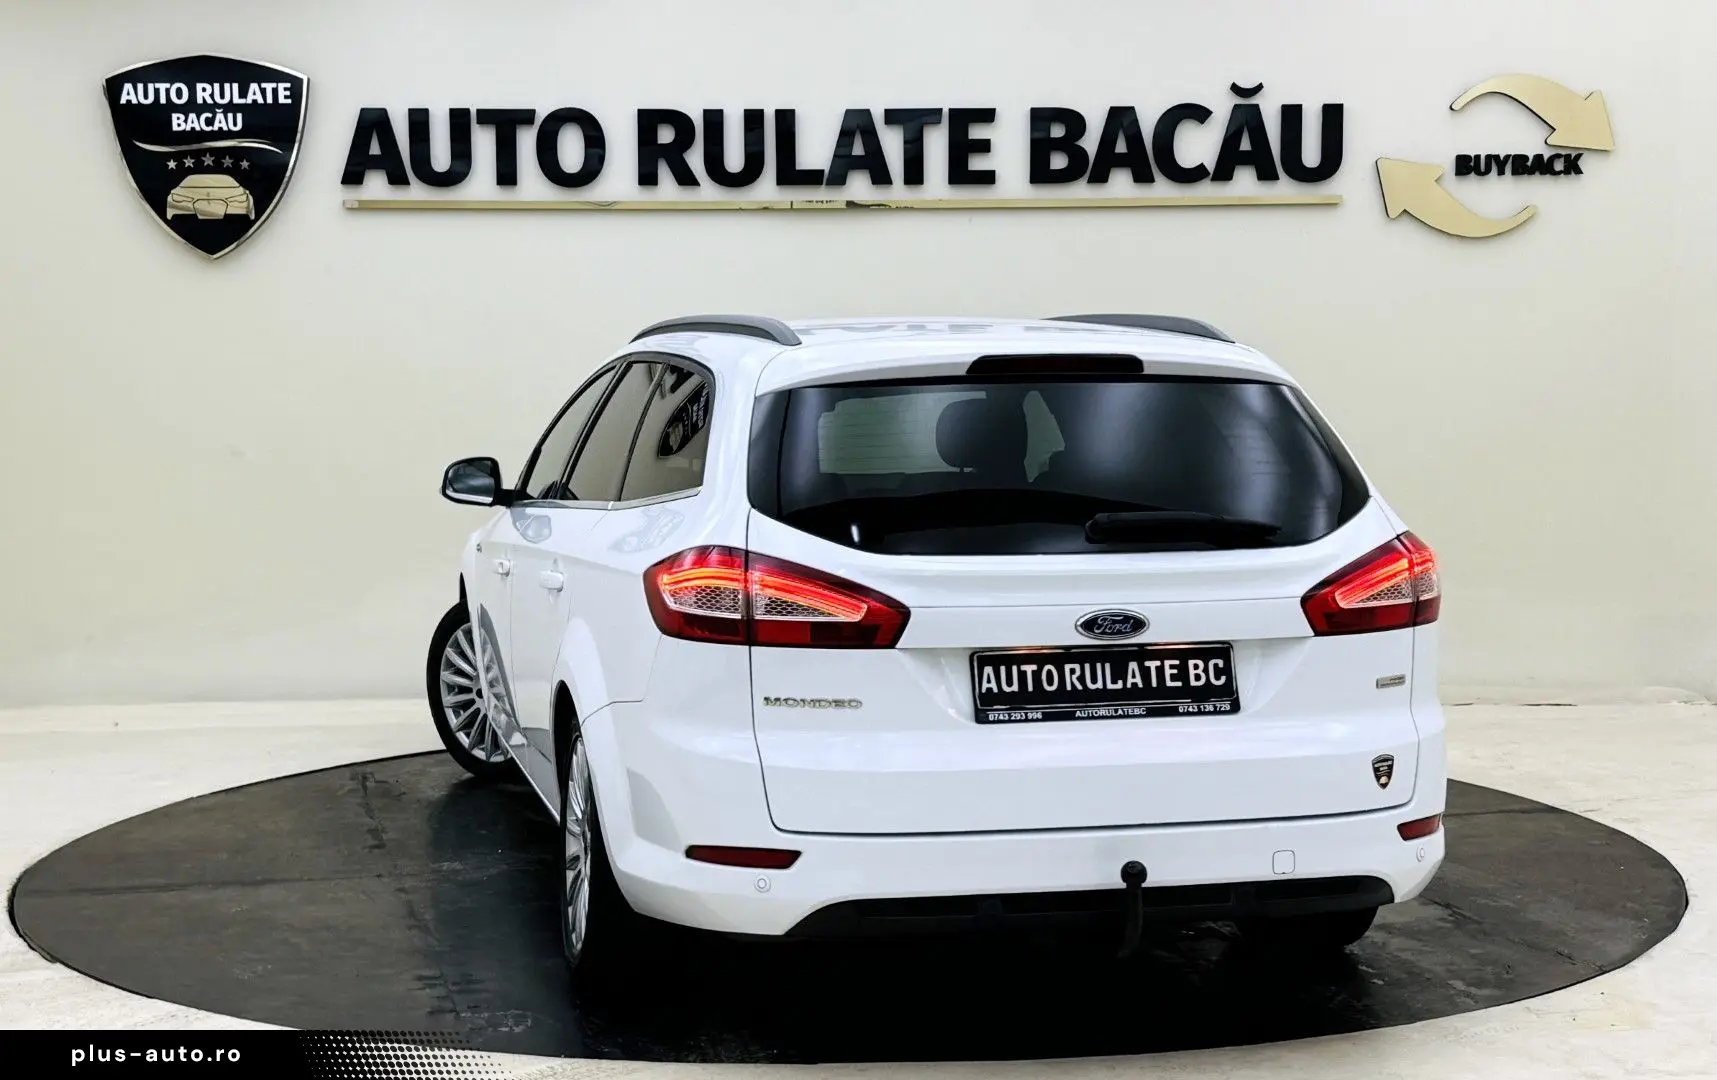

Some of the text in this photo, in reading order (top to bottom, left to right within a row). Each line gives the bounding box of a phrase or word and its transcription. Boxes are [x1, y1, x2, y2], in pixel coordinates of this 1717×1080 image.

[120, 83, 292, 105] AUTO RULATE
[171, 108, 243, 131] BACĂU
[341, 81, 1345, 188] AUTO RULATE BACĂU
[1455, 152, 1584, 177] BUYBACK
[1094, 616, 1133, 634] Ford
[1188, 659, 1227, 687] BC
[763, 696, 863, 709] MONDEO
[1075, 707, 1147, 718] AUTORULATEBC
[1178, 704, 1198, 713] 0743
[1216, 702, 1231, 711] 729
[988, 713, 1009, 721] 0743
[1010, 712, 1026, 720] 293
